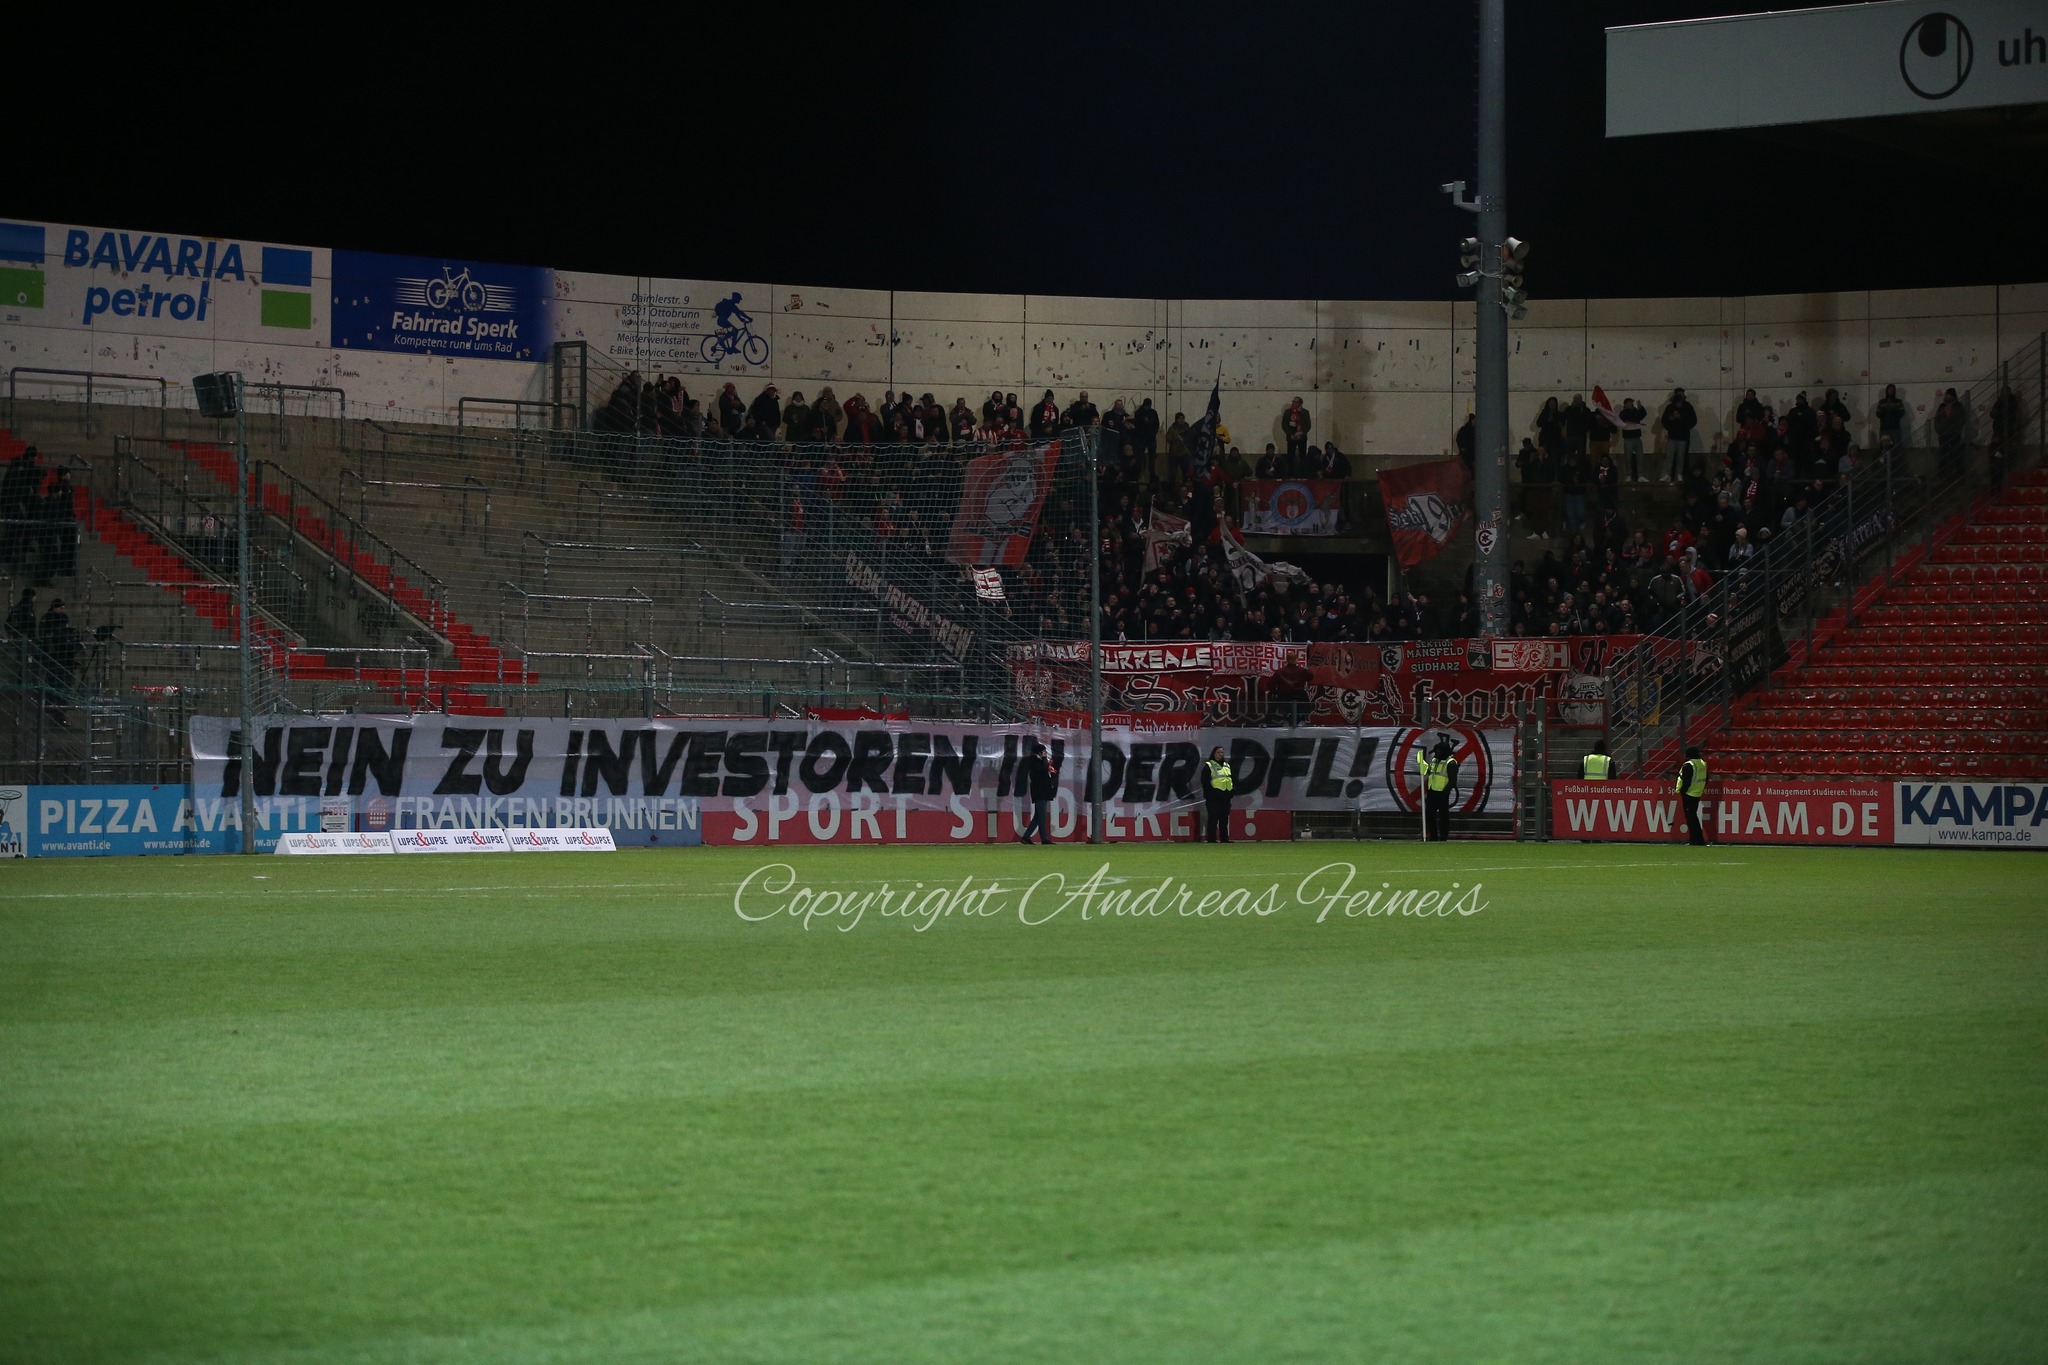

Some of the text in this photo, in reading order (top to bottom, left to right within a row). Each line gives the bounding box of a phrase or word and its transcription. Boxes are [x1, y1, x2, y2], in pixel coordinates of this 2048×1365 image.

[1998, 28, 2046, 67] uh
[64, 229, 245, 281] BAVARIA
[82, 280, 210, 325] petrol
[631, 293, 690, 305] Daimlerstr. 9
[621, 306, 700, 318] 85521 Ottobrunn
[392, 311, 519, 341] Fahrrad Sperk
[621, 319, 700, 329] www.fahrrad-sperk.de
[394, 333, 513, 353] Kompetenz rund ums Rad
[617, 333, 690, 345] Meisterwerkstatt
[609, 345, 699, 359] E-Bike Service Center
[1415, 640, 1454, 648] SEKTION
[1406, 647, 1465, 659] MANSFELD
[1212, 657, 1306, 673] QUERFU
[1410, 661, 1460, 673] SÜDHARZ
[220, 727, 1380, 802] NEIN ZU INVESTOREN IN DER DFL!
[1564, 786, 1589, 794] Fußball
[1590, 786, 1624, 794] studieren:
[1625, 786, 1653, 794] fham.de
[1722, 786, 1751, 795] fham.de
[1766, 787, 1811, 797] Management
[1812, 787, 1848, 797] studieren:
[1849, 788, 1879, 797] fham.de
[40, 799, 158, 834] PIZZA
[172, 797, 307, 832] AVANTI
[395, 797, 697, 831] FRANKEN BRUNNEN
[732, 787, 914, 841] SPORT
[1565, 798, 1879, 837] WWW.FHAM.DE
[1938, 828, 2032, 843] www.kampa.de
[42, 840, 111, 851] www.avanti.de
[144, 838, 211, 850] www.avanti.de
